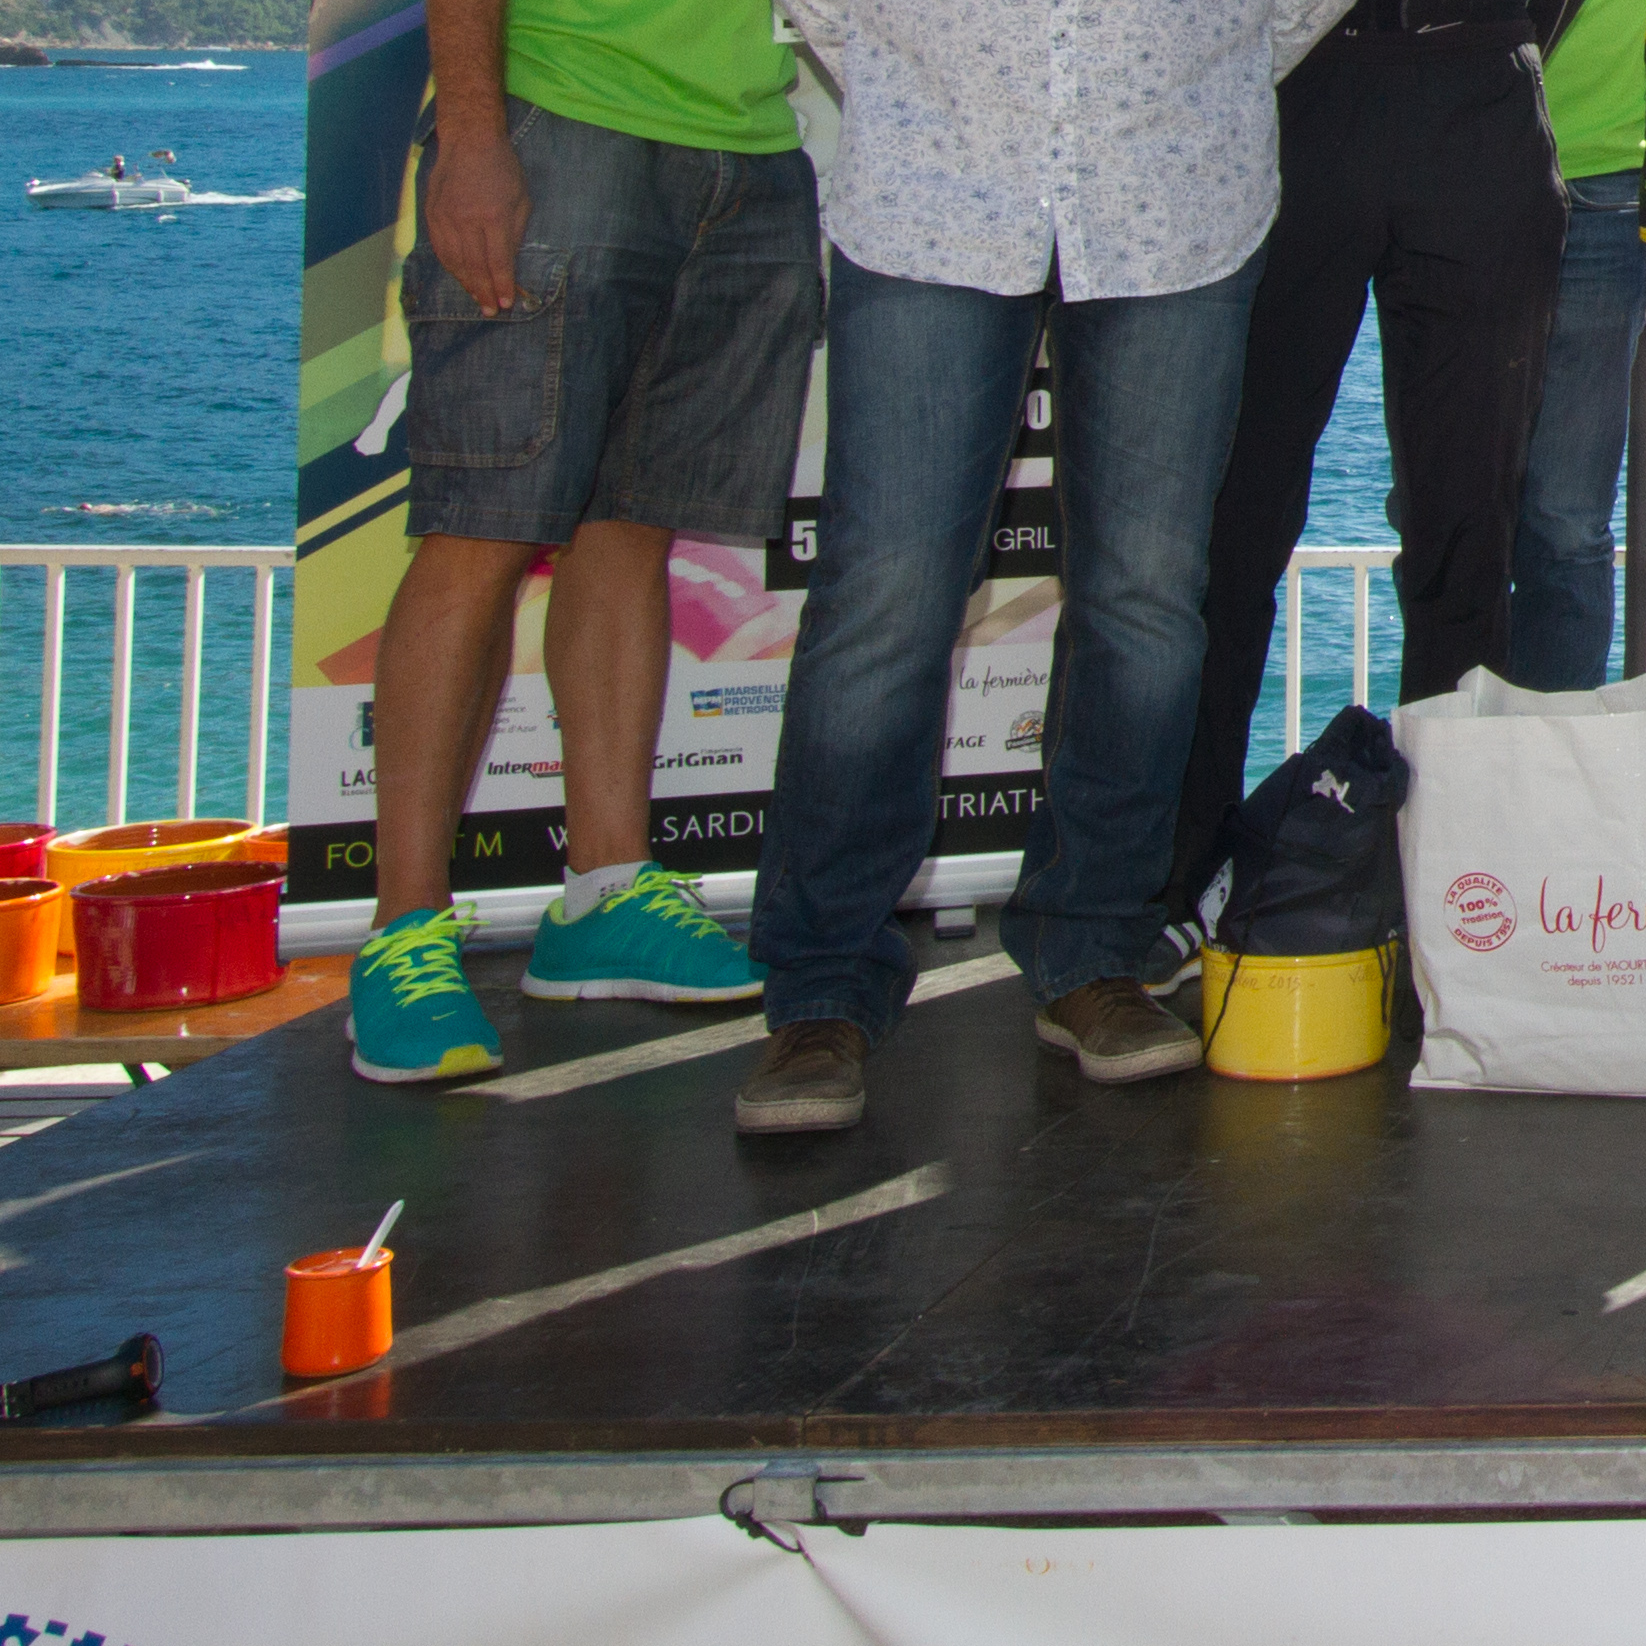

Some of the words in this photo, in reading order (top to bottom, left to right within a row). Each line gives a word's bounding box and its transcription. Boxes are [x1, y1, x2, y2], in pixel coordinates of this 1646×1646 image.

[473, 831, 503, 860] M
[1447, 890, 1458, 905] LA
[1458, 897, 1499, 914] 100%
[1539, 874, 1584, 934] la
[1460, 910, 1505, 925] Tradition
[1453, 927, 1493, 948] DEPUIS
[1496, 917, 1513, 942] 1952
[1541, 960, 1585, 973] Créateur
[1587, 959, 1602, 972] de
[1567, 974, 1602, 989] depuis
[1605, 974, 1636, 986] 1952
